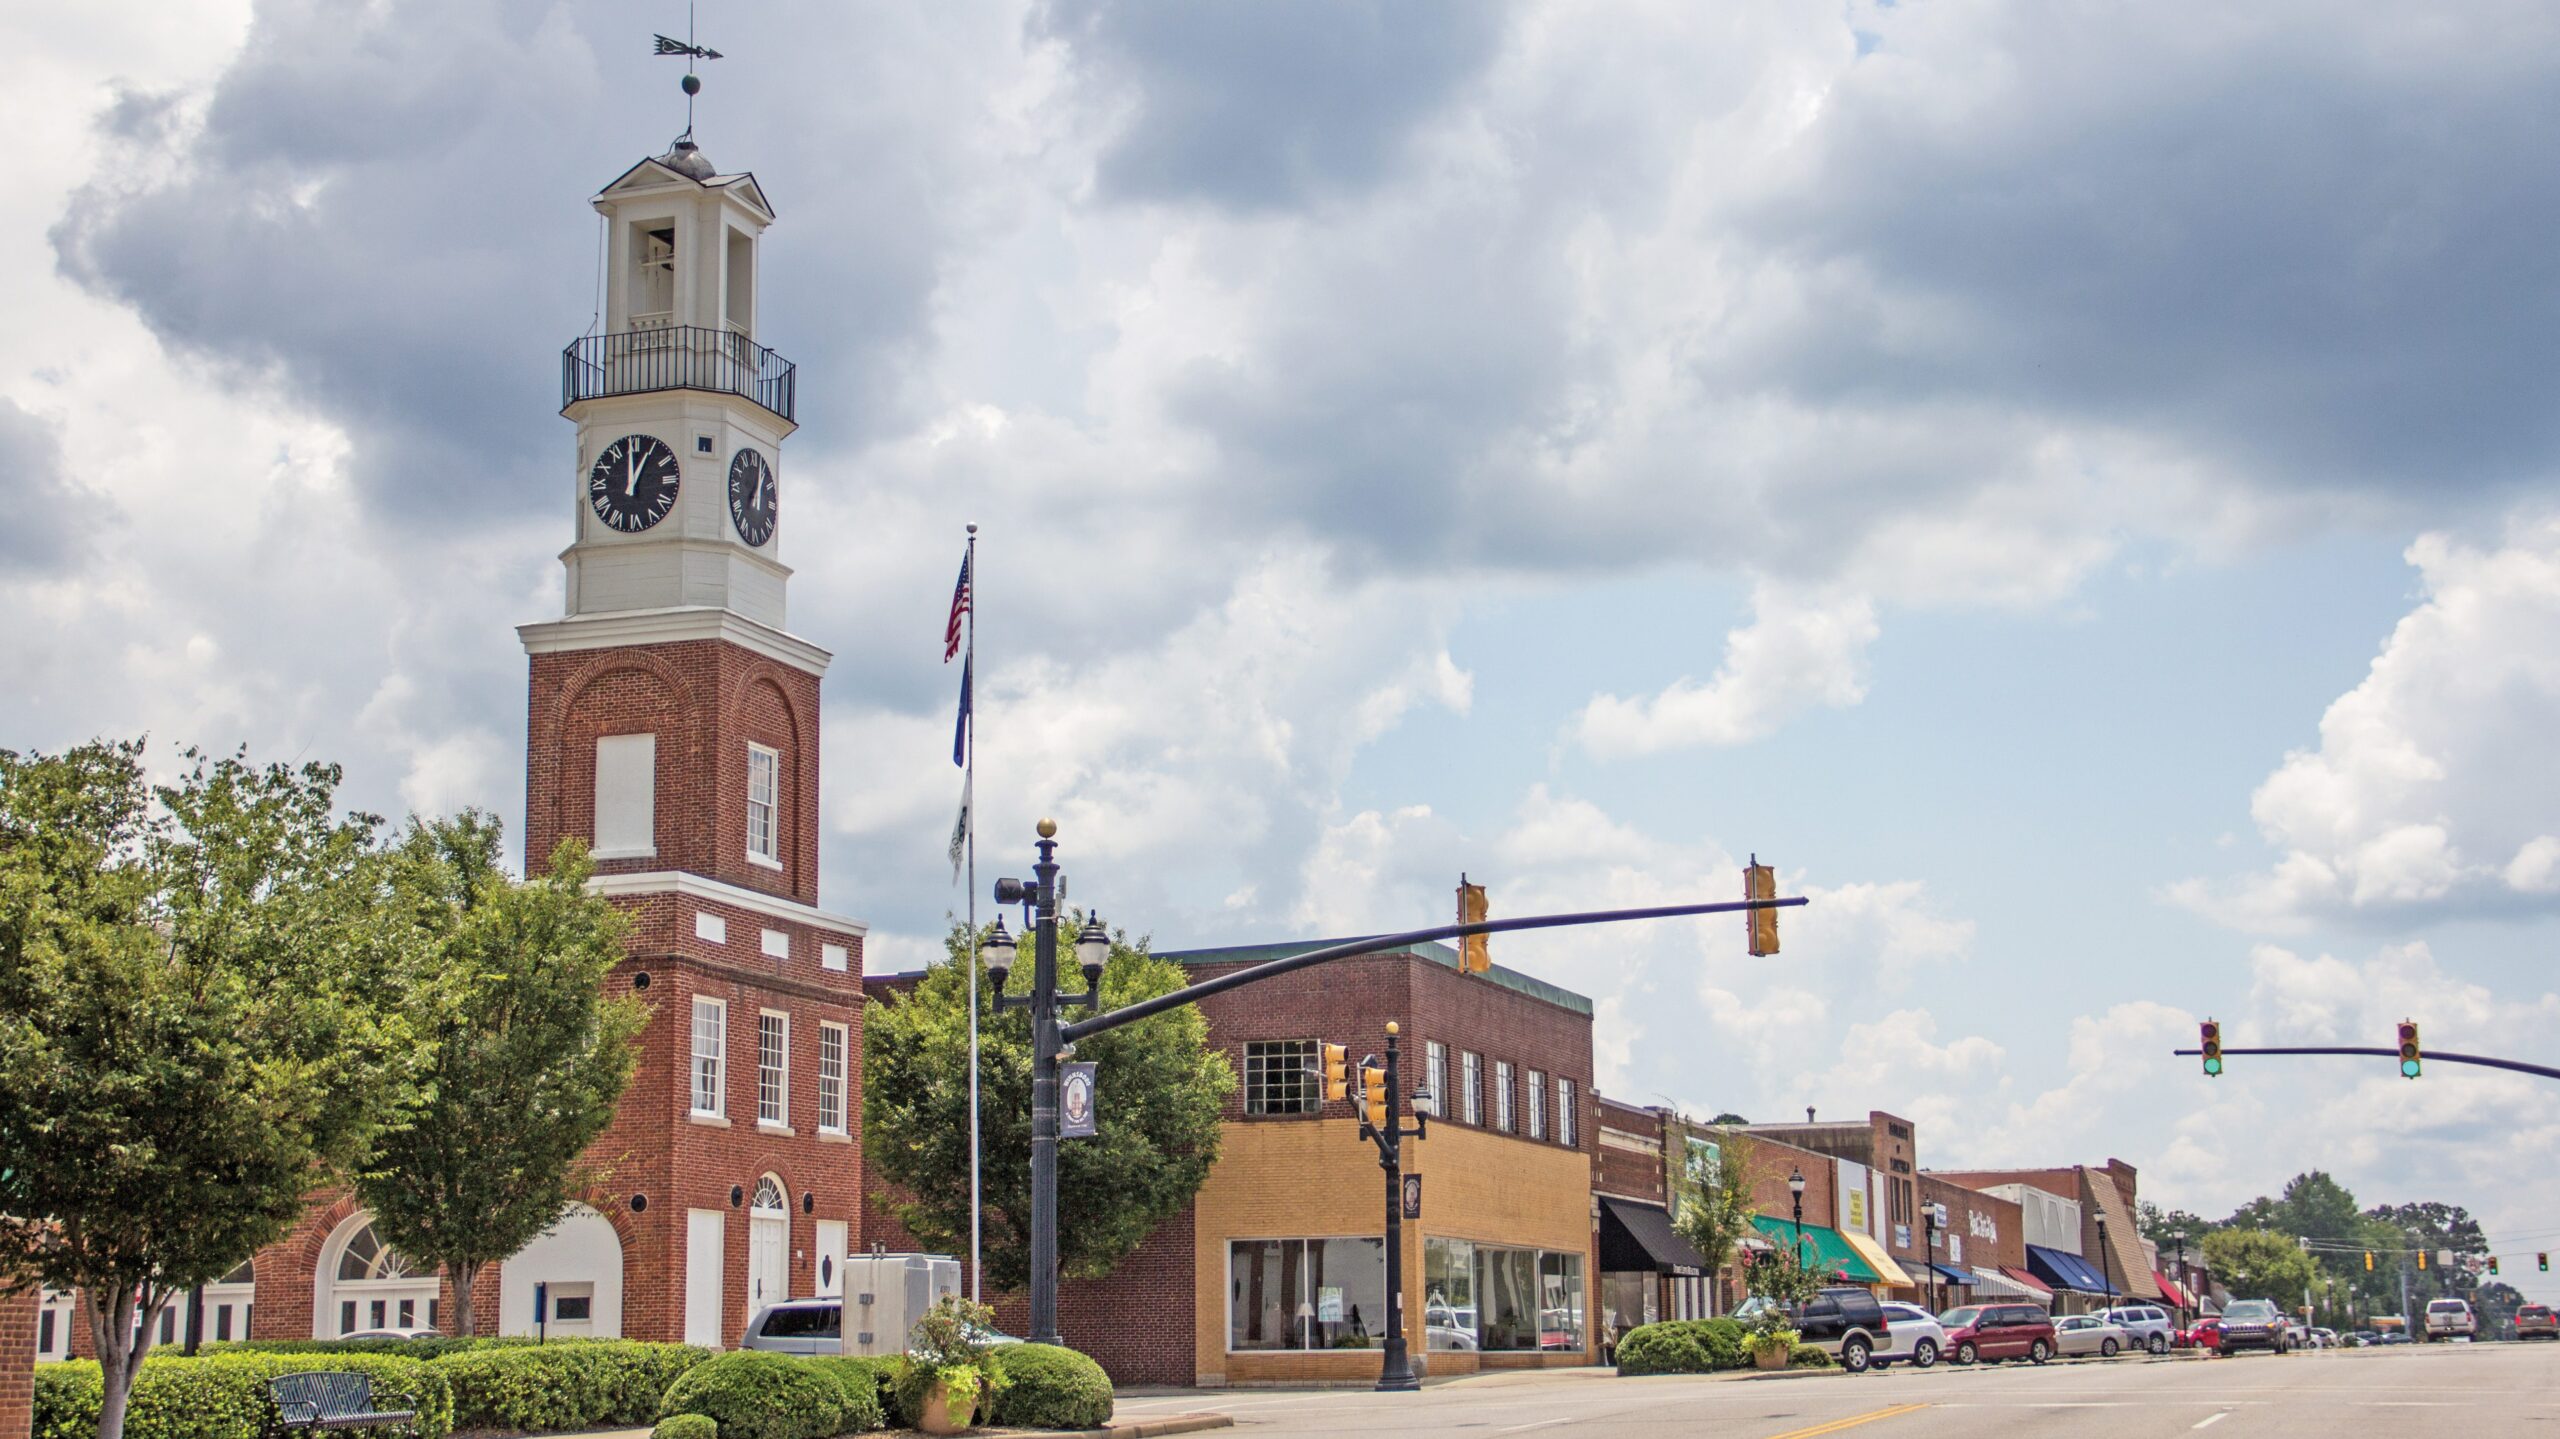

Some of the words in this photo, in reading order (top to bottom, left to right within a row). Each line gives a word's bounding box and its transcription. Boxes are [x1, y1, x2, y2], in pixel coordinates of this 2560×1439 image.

[608, 444, 622, 463] XI
[658, 455, 672, 467] II
[597, 461, 611, 475] X
[592, 478, 606, 490] IX
[662, 475, 677, 484] III
[595, 495, 611, 518] VIII
[657, 493, 672, 512] IV
[609, 509, 623, 528] VII
[630, 514, 644, 529] VI
[648, 508, 660, 523] V
